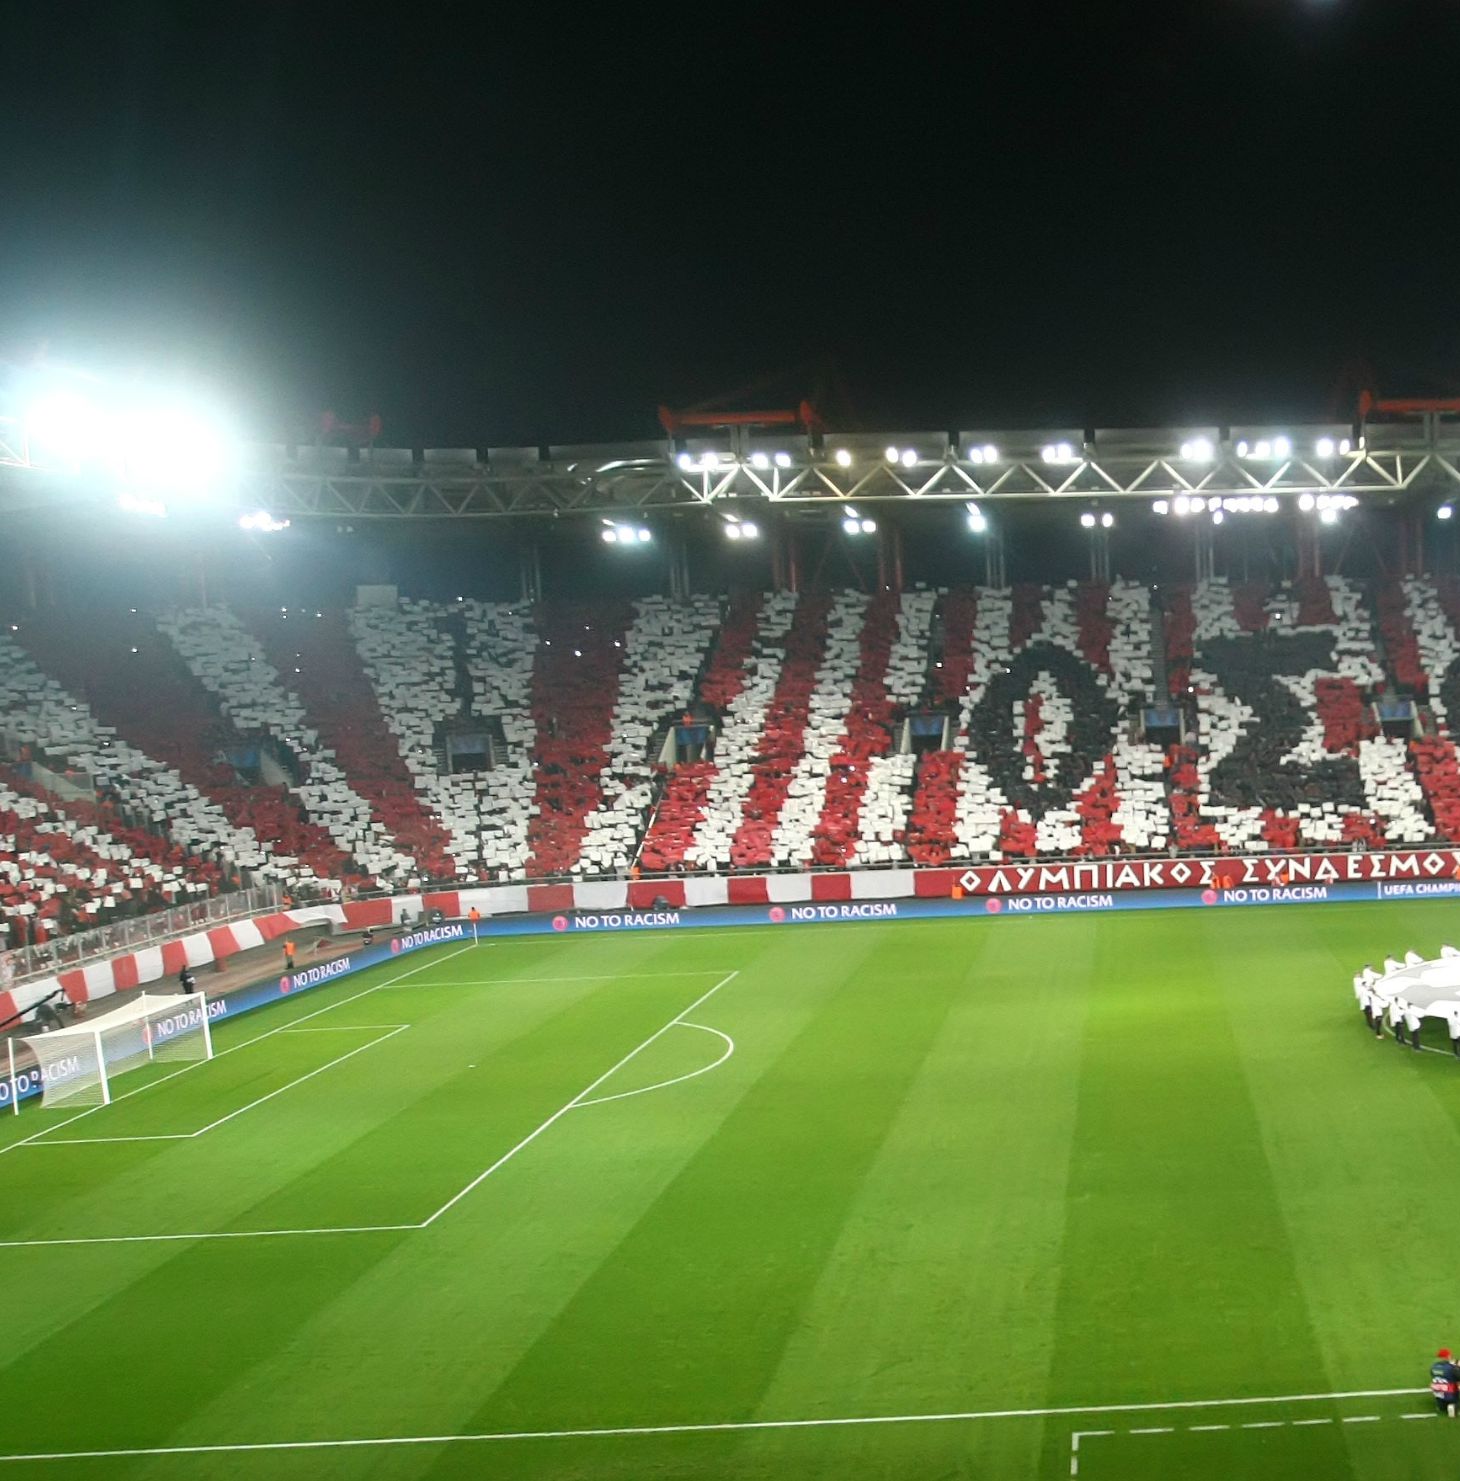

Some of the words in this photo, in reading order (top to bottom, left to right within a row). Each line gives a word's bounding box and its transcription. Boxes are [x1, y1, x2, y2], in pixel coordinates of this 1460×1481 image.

[960, 861, 1215, 892] ΟΛΥΜΠΙΑΚΟΣ
[1224, 889, 1249, 902] NO
[1251, 888, 1271, 901] TO
[1273, 887, 1328, 900] RACISM
[1384, 884, 1414, 895] UEFA
[1008, 898, 1033, 910] NO
[1034, 897, 1055, 909] TO
[1058, 895, 1113, 909] RACISM
[792, 907, 815, 919] NO
[818, 906, 838, 918] TO
[841, 903, 897, 916] RACISM
[575, 916, 599, 928] NO
[601, 915, 621, 927] TO
[624, 912, 680, 926] RACISM
[401, 936, 414, 949] NO
[413, 934, 424, 947] TO
[423, 924, 463, 944] RACISM
[293, 972, 307, 988] NO
[307, 969, 320, 985] TO
[319, 957, 351, 979] RACISM
[157, 1019, 174, 1038] NO
[172, 1013, 189, 1030] TO
[188, 999, 227, 1025] RAISM
